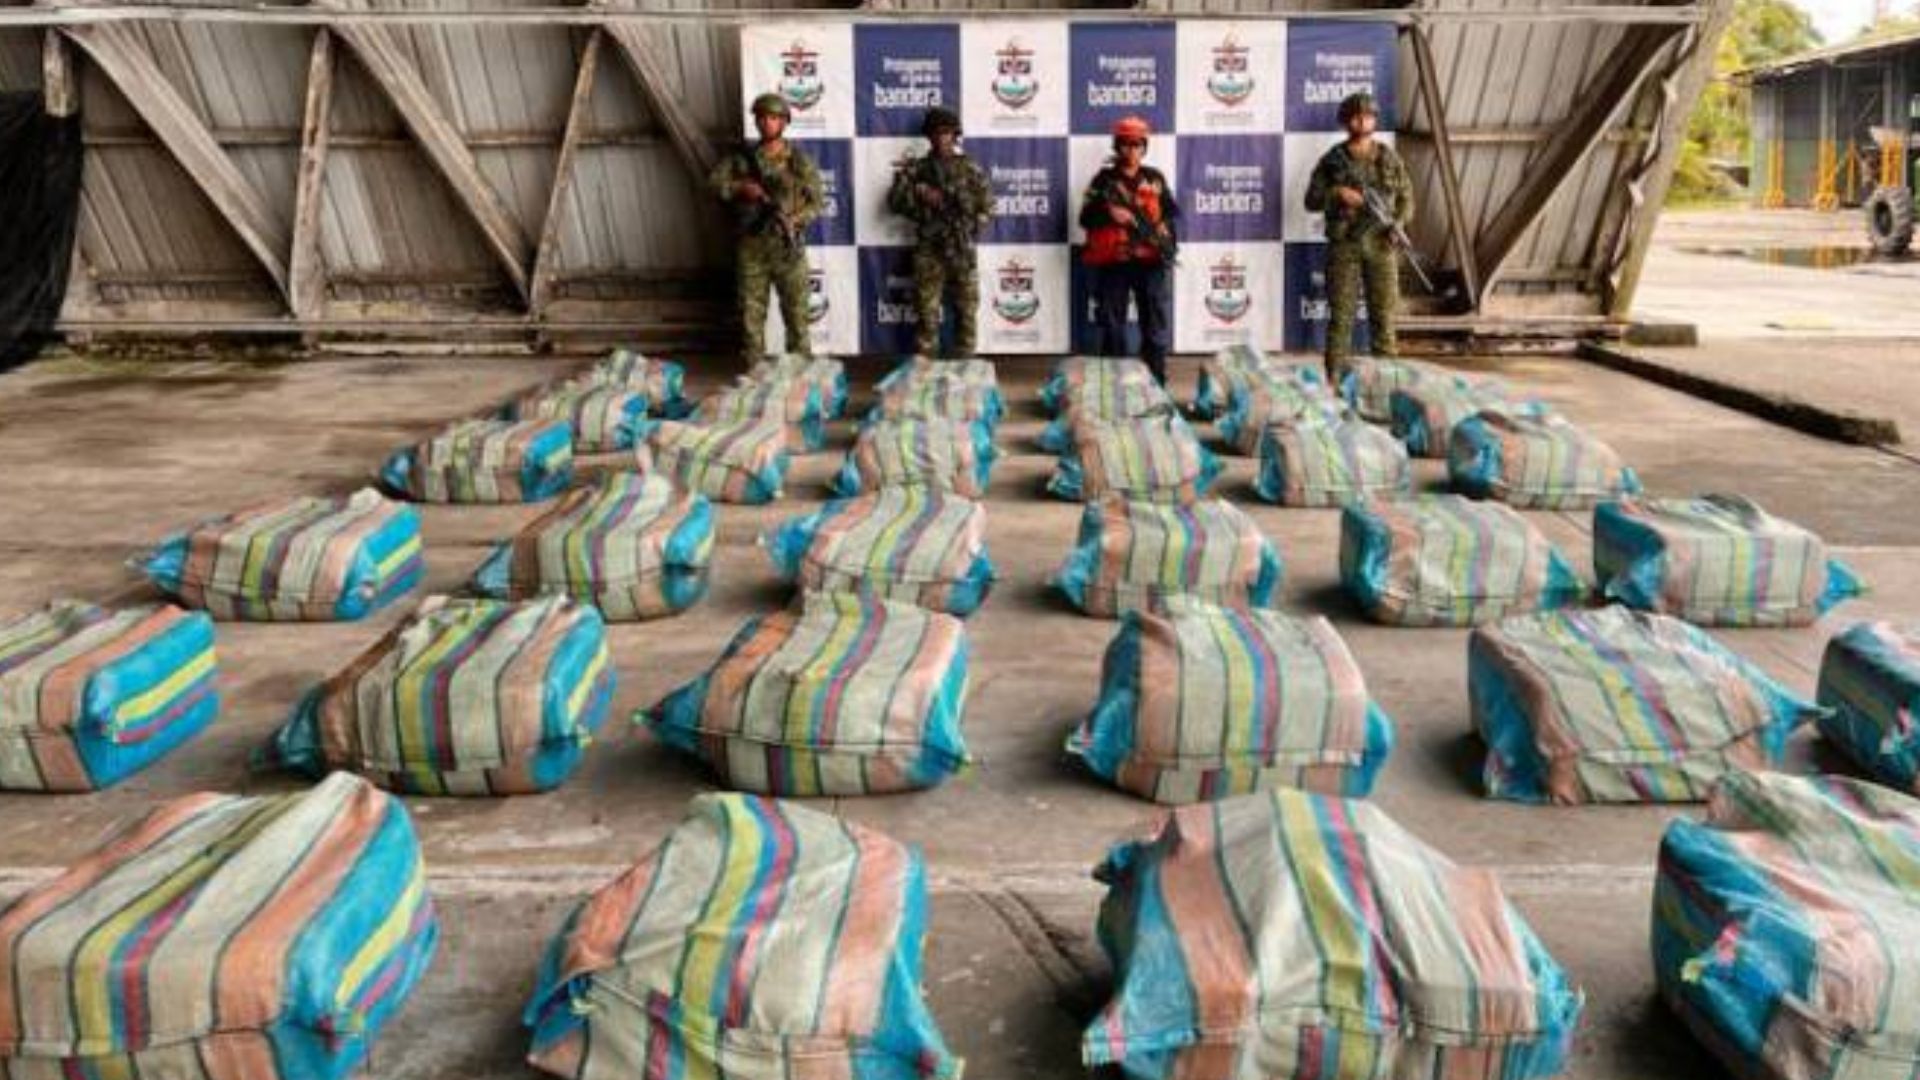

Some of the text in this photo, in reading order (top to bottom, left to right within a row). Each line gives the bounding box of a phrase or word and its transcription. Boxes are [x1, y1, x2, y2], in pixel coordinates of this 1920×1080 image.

[874, 81, 943, 107] bandera
[1088, 80, 1156, 106] bandera
[988, 189, 1048, 215] andera
[1195, 189, 1263, 213] bandera
